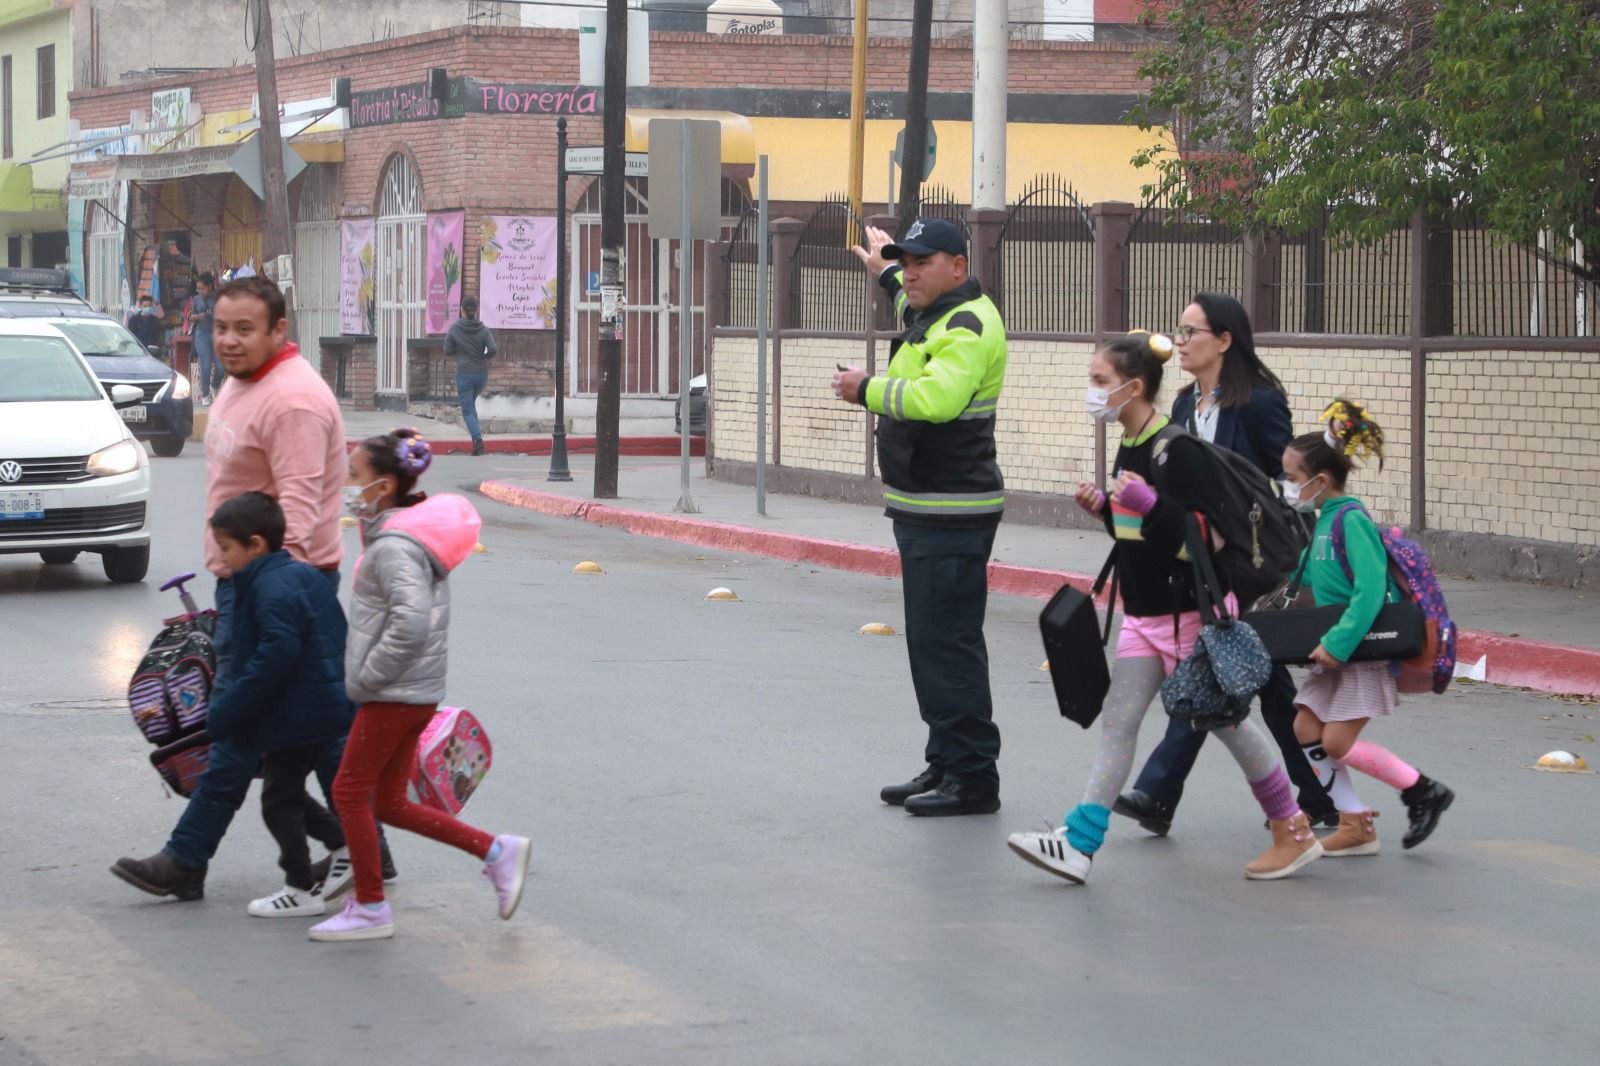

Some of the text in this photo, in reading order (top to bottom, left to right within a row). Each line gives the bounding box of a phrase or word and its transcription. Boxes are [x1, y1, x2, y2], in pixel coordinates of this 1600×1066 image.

[351, 91, 391, 126] Florería
[479, 80, 598, 113] Florería
[512, 292, 530, 303] Cajas
